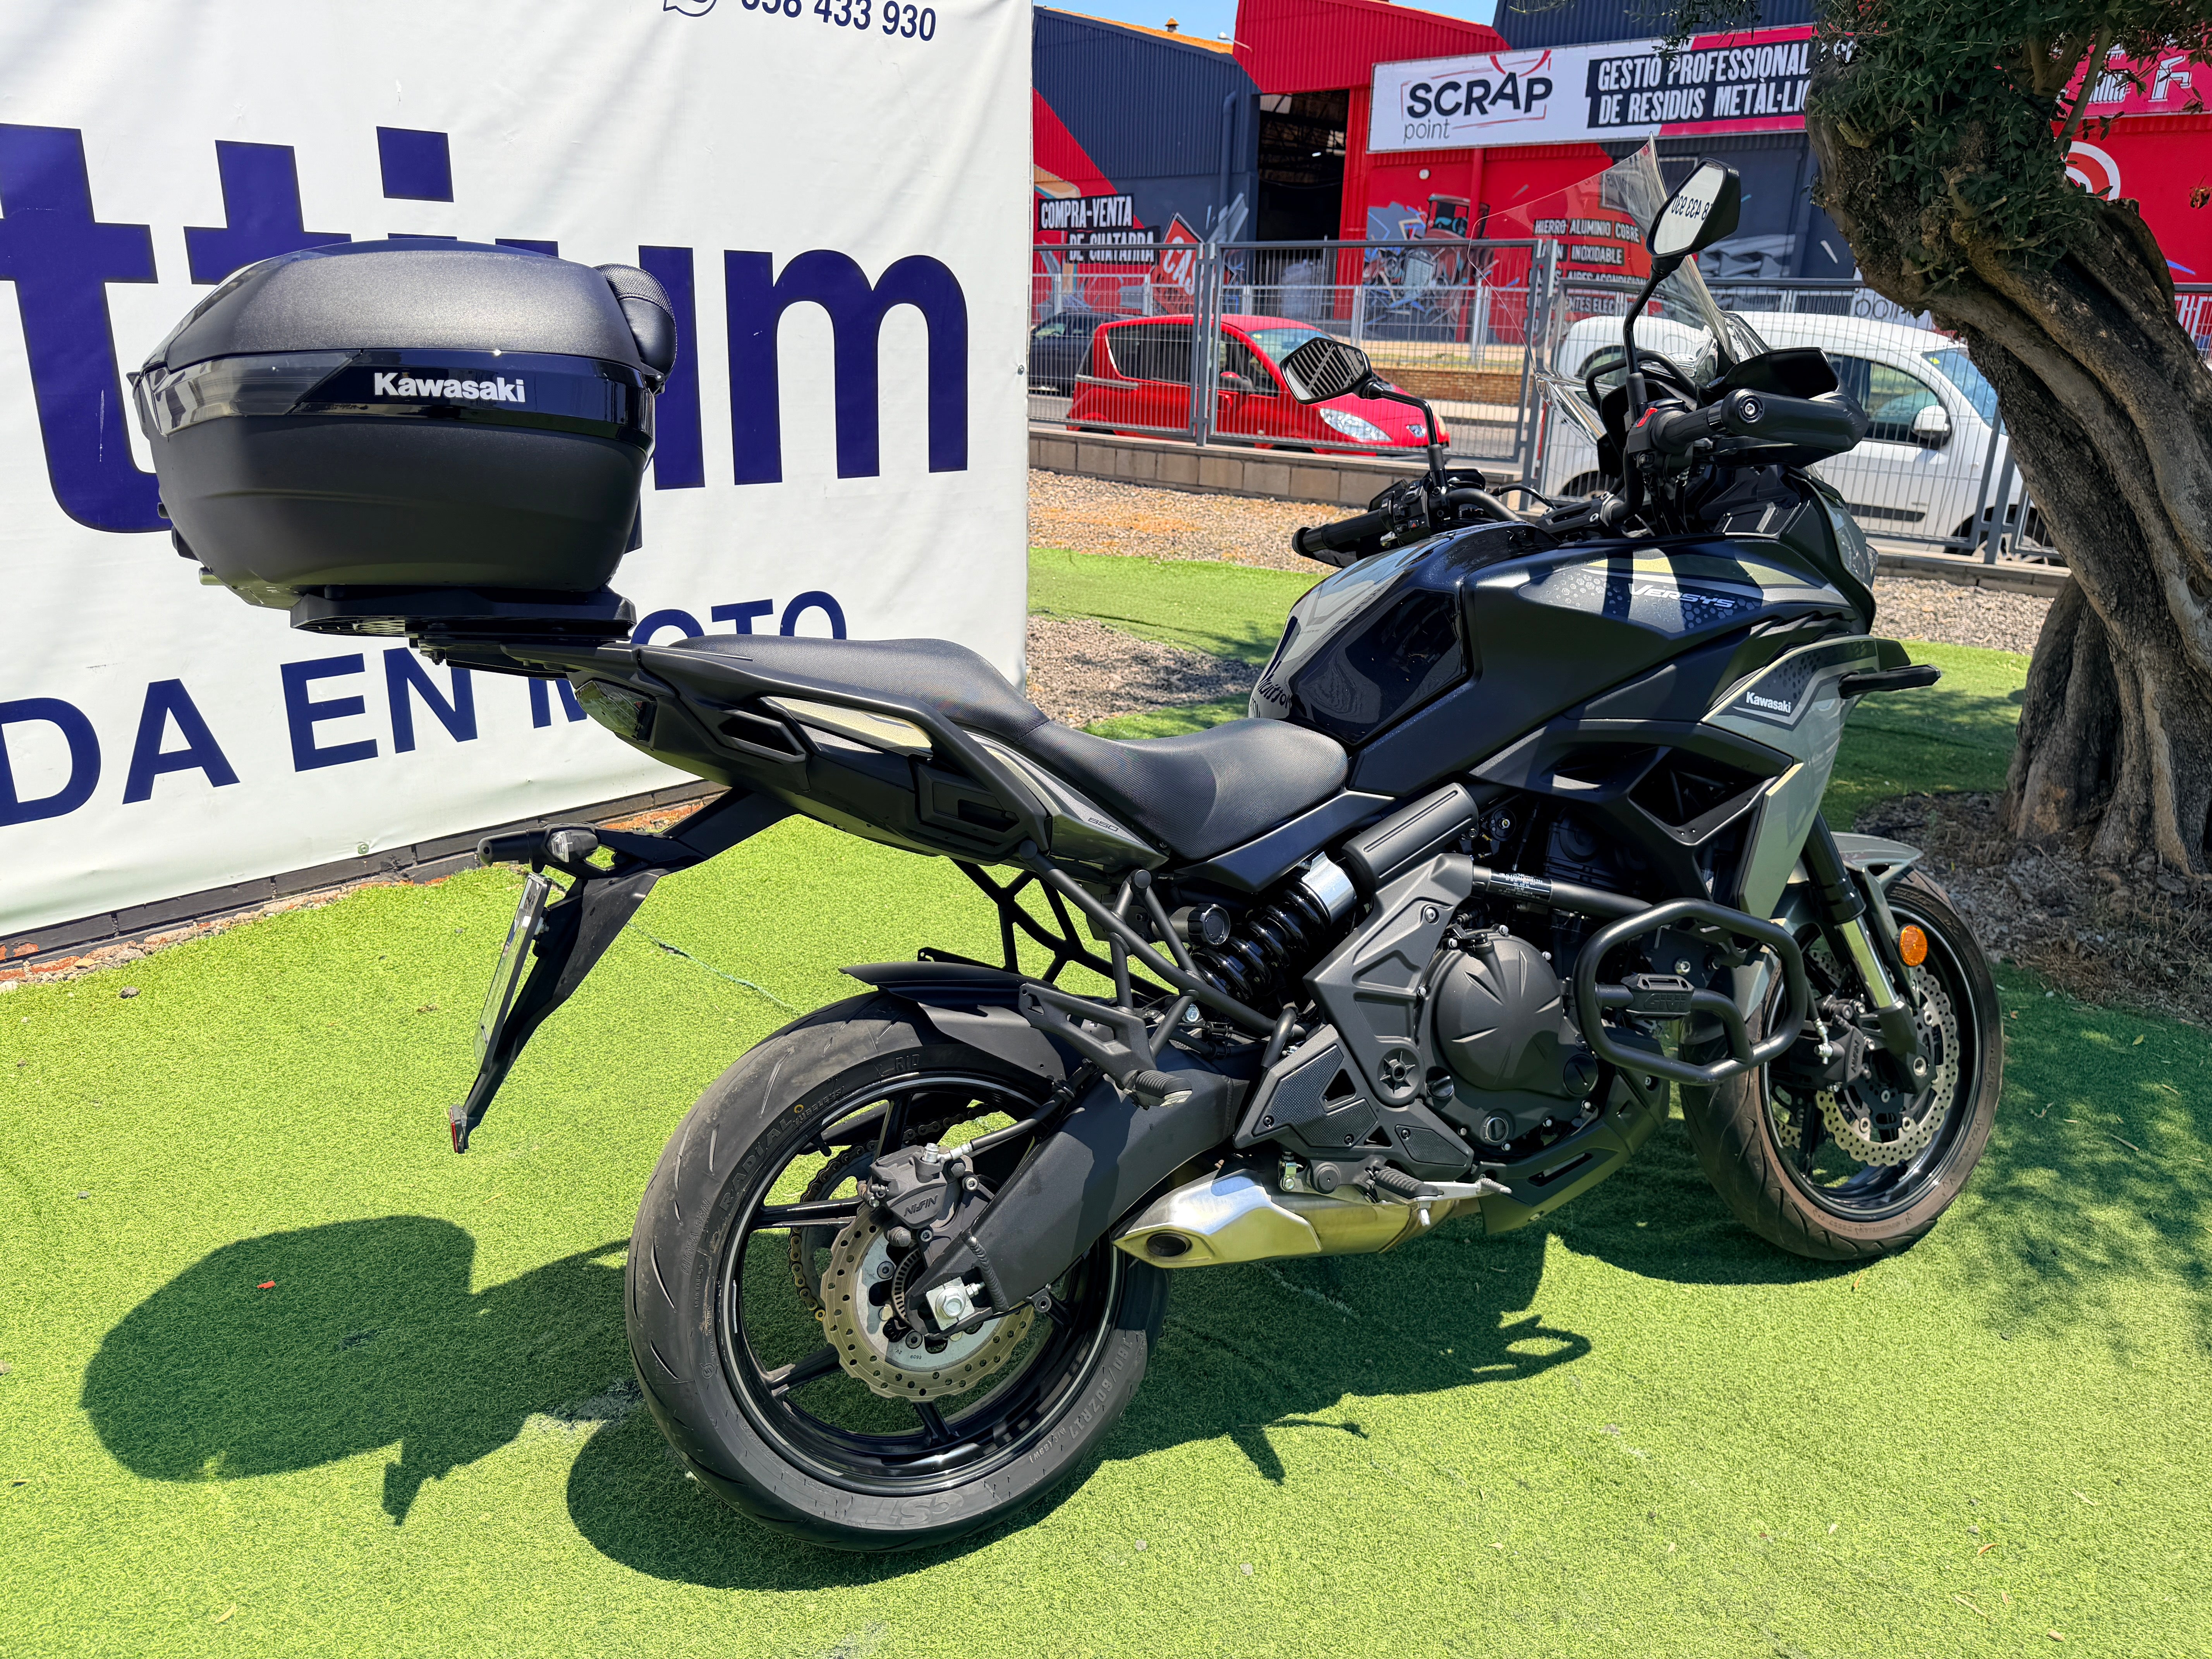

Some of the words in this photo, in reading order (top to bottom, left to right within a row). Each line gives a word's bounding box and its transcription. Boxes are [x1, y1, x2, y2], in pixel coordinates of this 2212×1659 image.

[814, 0, 871, 30] 433
[883, 0, 936, 41] 930
[1667, 43, 1811, 85] PROFESSIONAL
[1407, 72, 1553, 118] SCRAP
[1598, 94, 1623, 125] DE
[1627, 87, 1706, 123] RESIDUS
[1403, 119, 1450, 144] point
[1041, 196, 1132, 229] COMPRA-VENTA
[1534, 219, 1566, 234] HIERRO
[1569, 219, 1611, 237] ALUMINIO
[1615, 222, 1640, 243] COBRE
[1571, 244, 1623, 264] INOXIDABLE
[374, 373, 526, 402] Kawasaki
[1628, 583, 1735, 608] VERSYS
[1746, 691, 1791, 713] Kawasaki
[0, 678, 240, 827] DA
[280, 647, 478, 772] EN
[1087, 817, 1119, 832] 650
[719, 1118, 793, 1212] RADIAL
